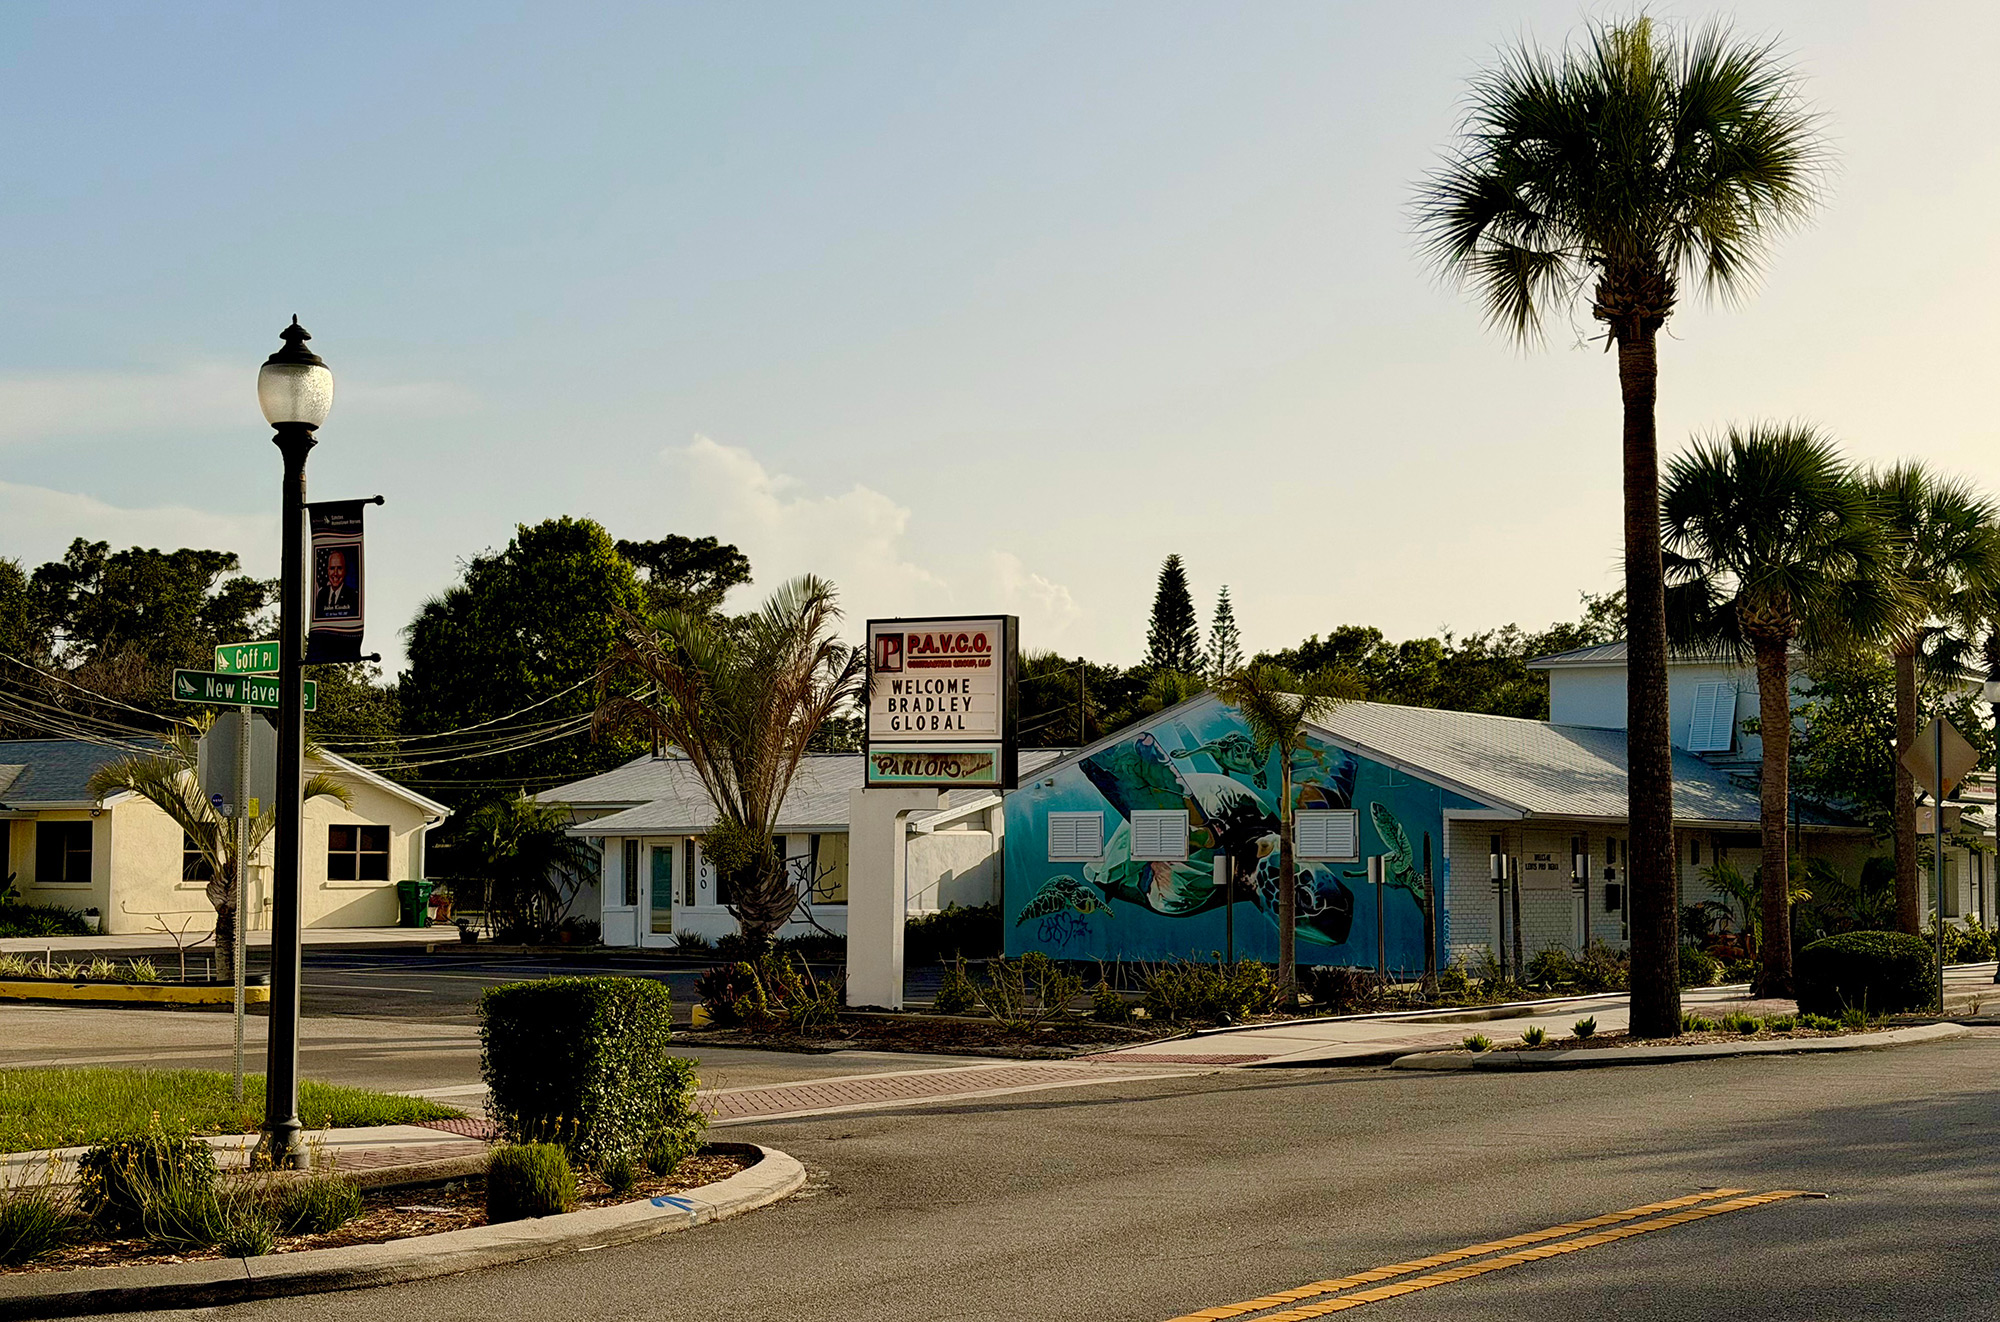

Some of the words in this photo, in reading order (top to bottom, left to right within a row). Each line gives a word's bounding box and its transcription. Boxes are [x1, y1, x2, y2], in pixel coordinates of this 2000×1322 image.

[907, 633, 992, 654] P.A.V.C.O.
[235, 648, 258, 669] Goff
[262, 652, 272, 667] Pl
[206, 677, 235, 698] New
[892, 679, 970, 694] WELCOME
[888, 697, 972, 712] BRADLEY
[891, 715, 965, 730] GLOBAL
[878, 757, 961, 778] PARLOR
